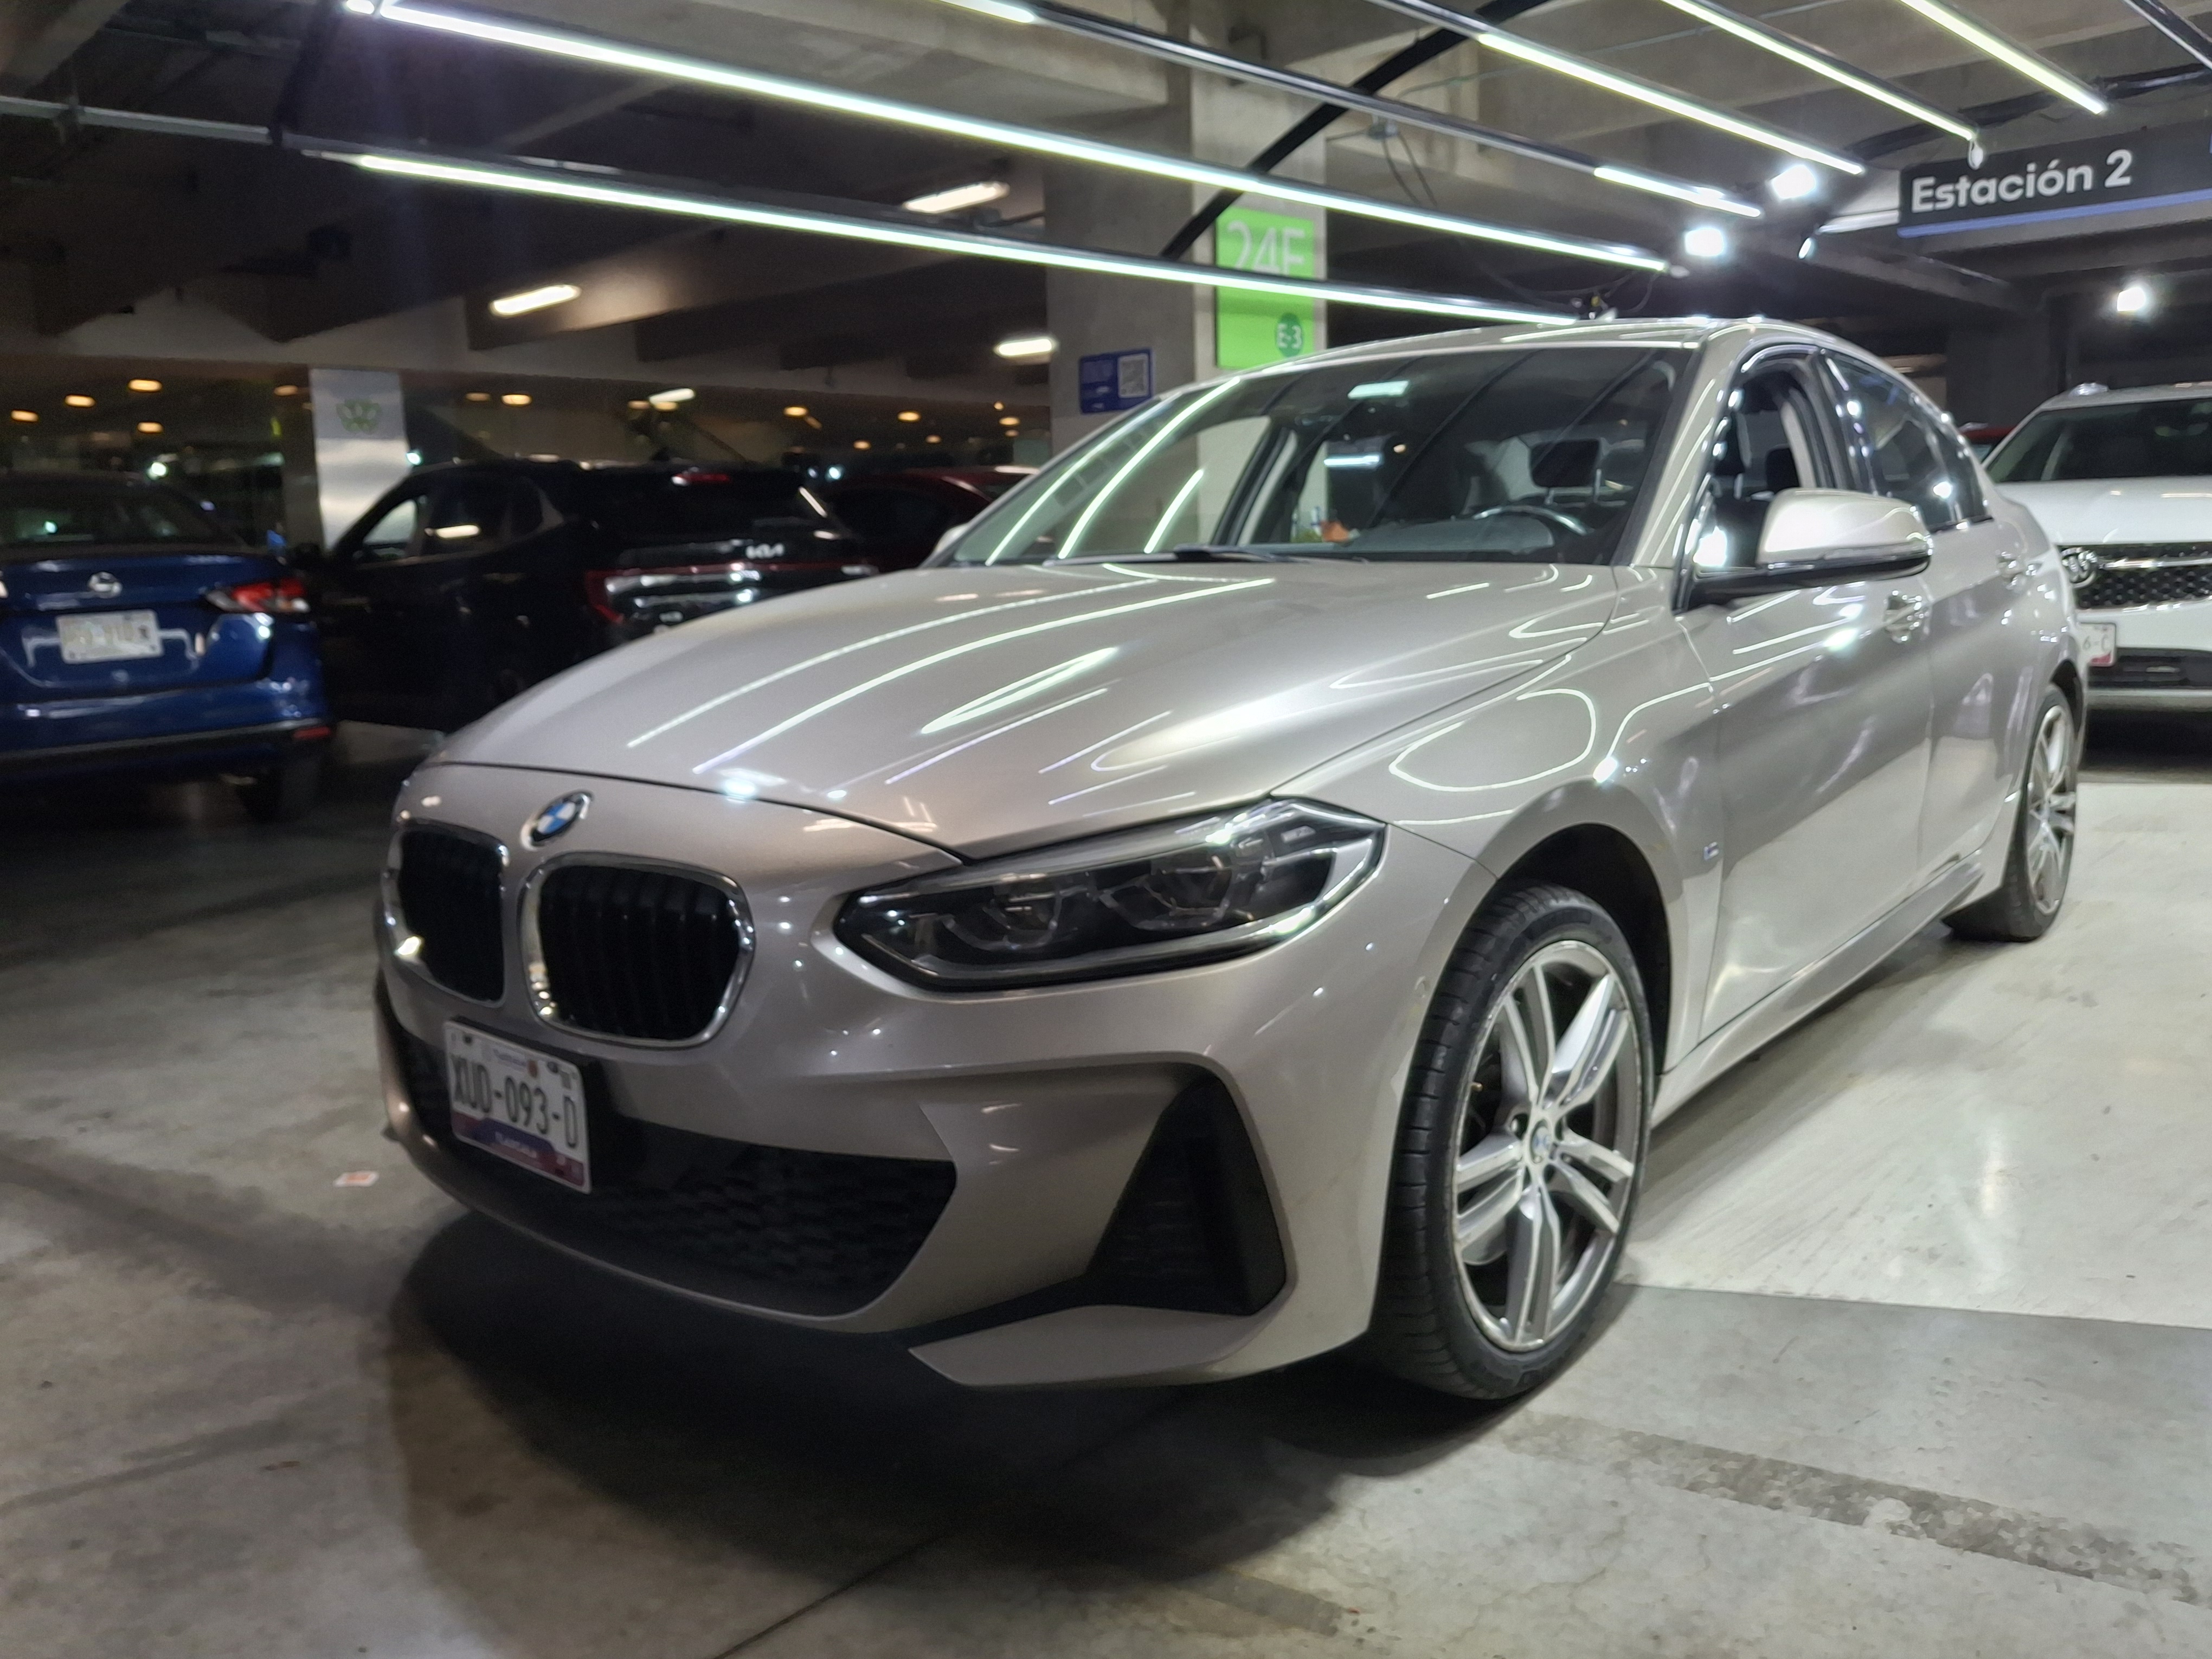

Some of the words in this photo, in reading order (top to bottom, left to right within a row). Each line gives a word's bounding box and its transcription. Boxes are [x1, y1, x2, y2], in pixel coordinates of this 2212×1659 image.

[1912, 159, 2093, 213] Estación
[2104, 149, 2132, 188] 2
[449, 1054, 578, 1149] XUD-093-D
